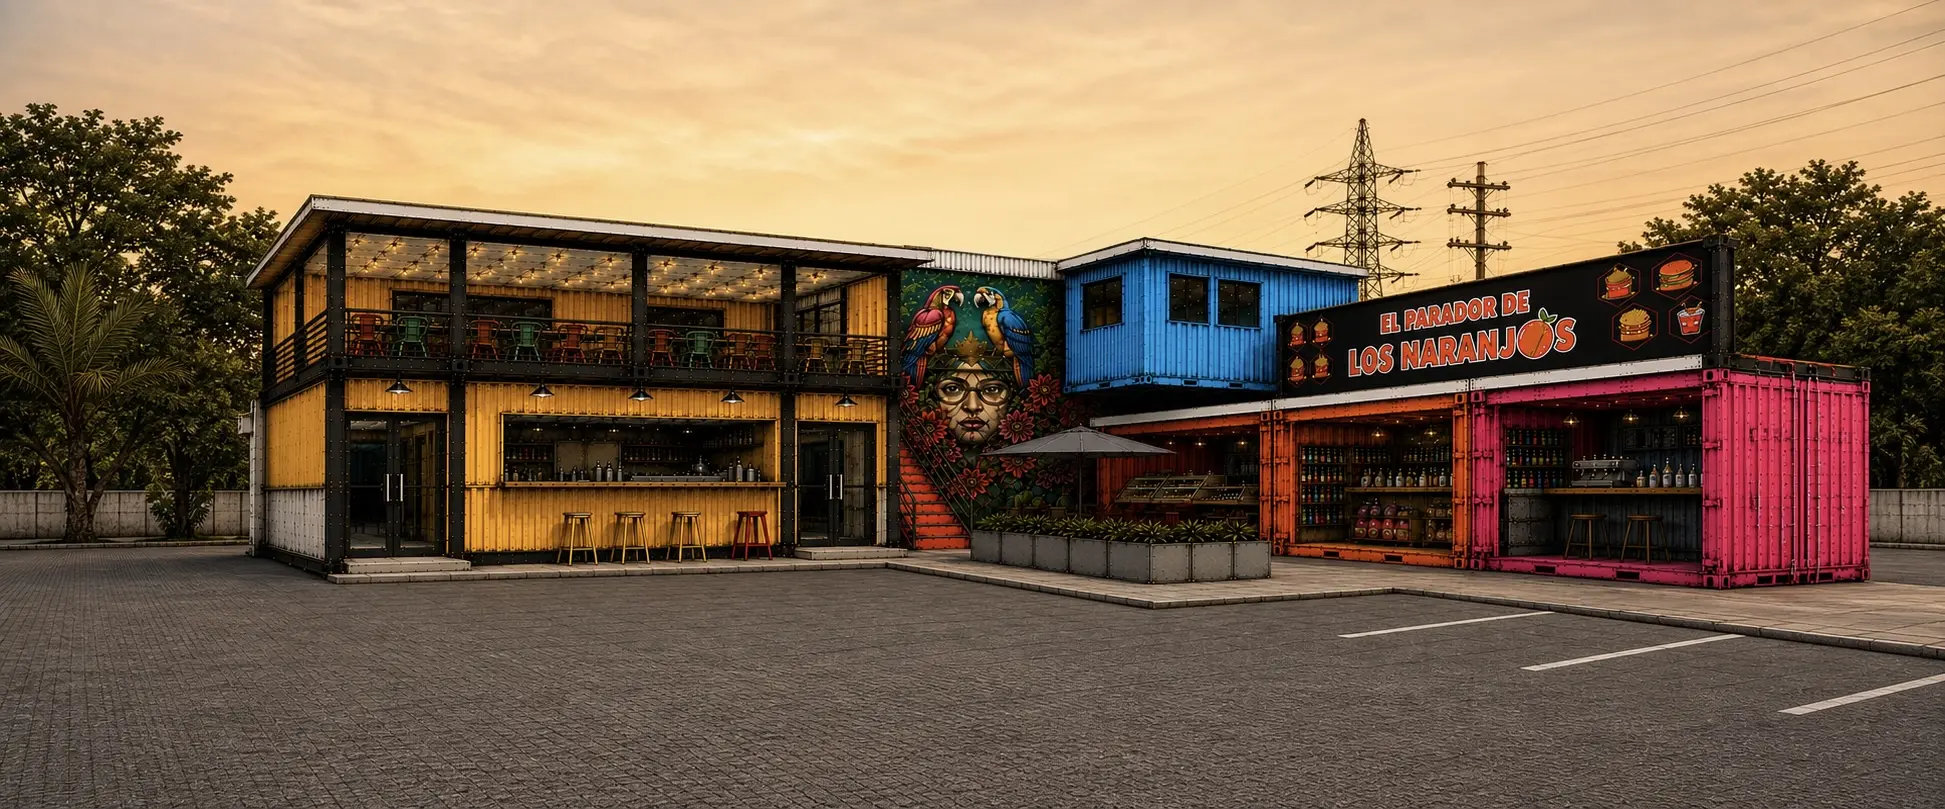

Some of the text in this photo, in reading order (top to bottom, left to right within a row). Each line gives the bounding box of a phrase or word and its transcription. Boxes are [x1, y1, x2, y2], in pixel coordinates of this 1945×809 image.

[1380, 289, 1530, 334] EL PARADOR DE
[1348, 316, 1576, 377] LOS NARANJOS
